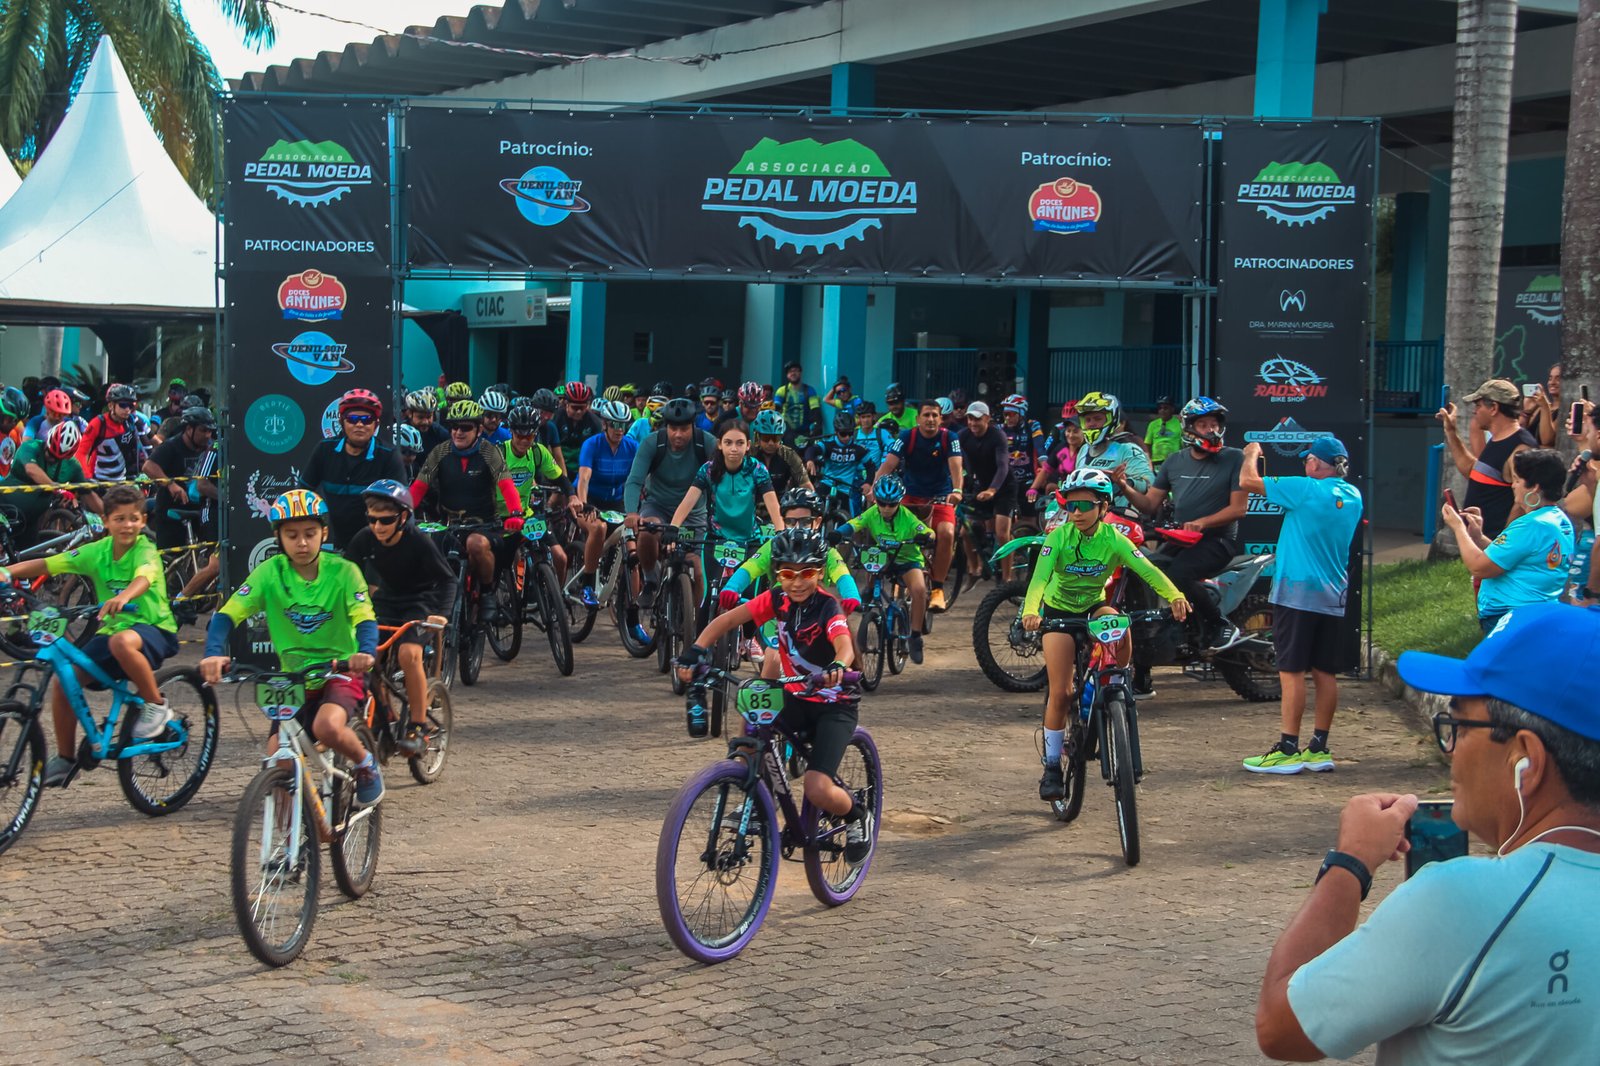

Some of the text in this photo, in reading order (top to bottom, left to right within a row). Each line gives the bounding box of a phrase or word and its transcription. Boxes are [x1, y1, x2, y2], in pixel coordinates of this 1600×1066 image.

[500, 140, 593, 157] Patrocínio:
[1021, 151, 1111, 167] Patrocínio:
[244, 163, 372, 179] PEDAL MOEDA
[519, 181, 580, 190] DENILSON
[703, 177, 918, 204] PEDAL MOEDA
[1238, 184, 1355, 199] PEDAL MOEDA
[545, 190, 574, 200] VAN
[1036, 205, 1096, 221] ANTUNES
[244, 239, 375, 253] PATROCINADORES
[1234, 257, 1354, 270] PATROCINADORES
[285, 296, 341, 309] ANTUNES
[1515, 293, 1548, 304] PEDAL
[476, 295, 505, 317] CIAC
[290, 344, 346, 354] DENILSON
[313, 353, 340, 362] VAN
[1249, 432, 1276, 442] Loja
[1277, 432, 1295, 441] do
[525, 523, 543, 533] 113
[1100, 619, 1119, 631] 30
[750, 693, 772, 709] 85
